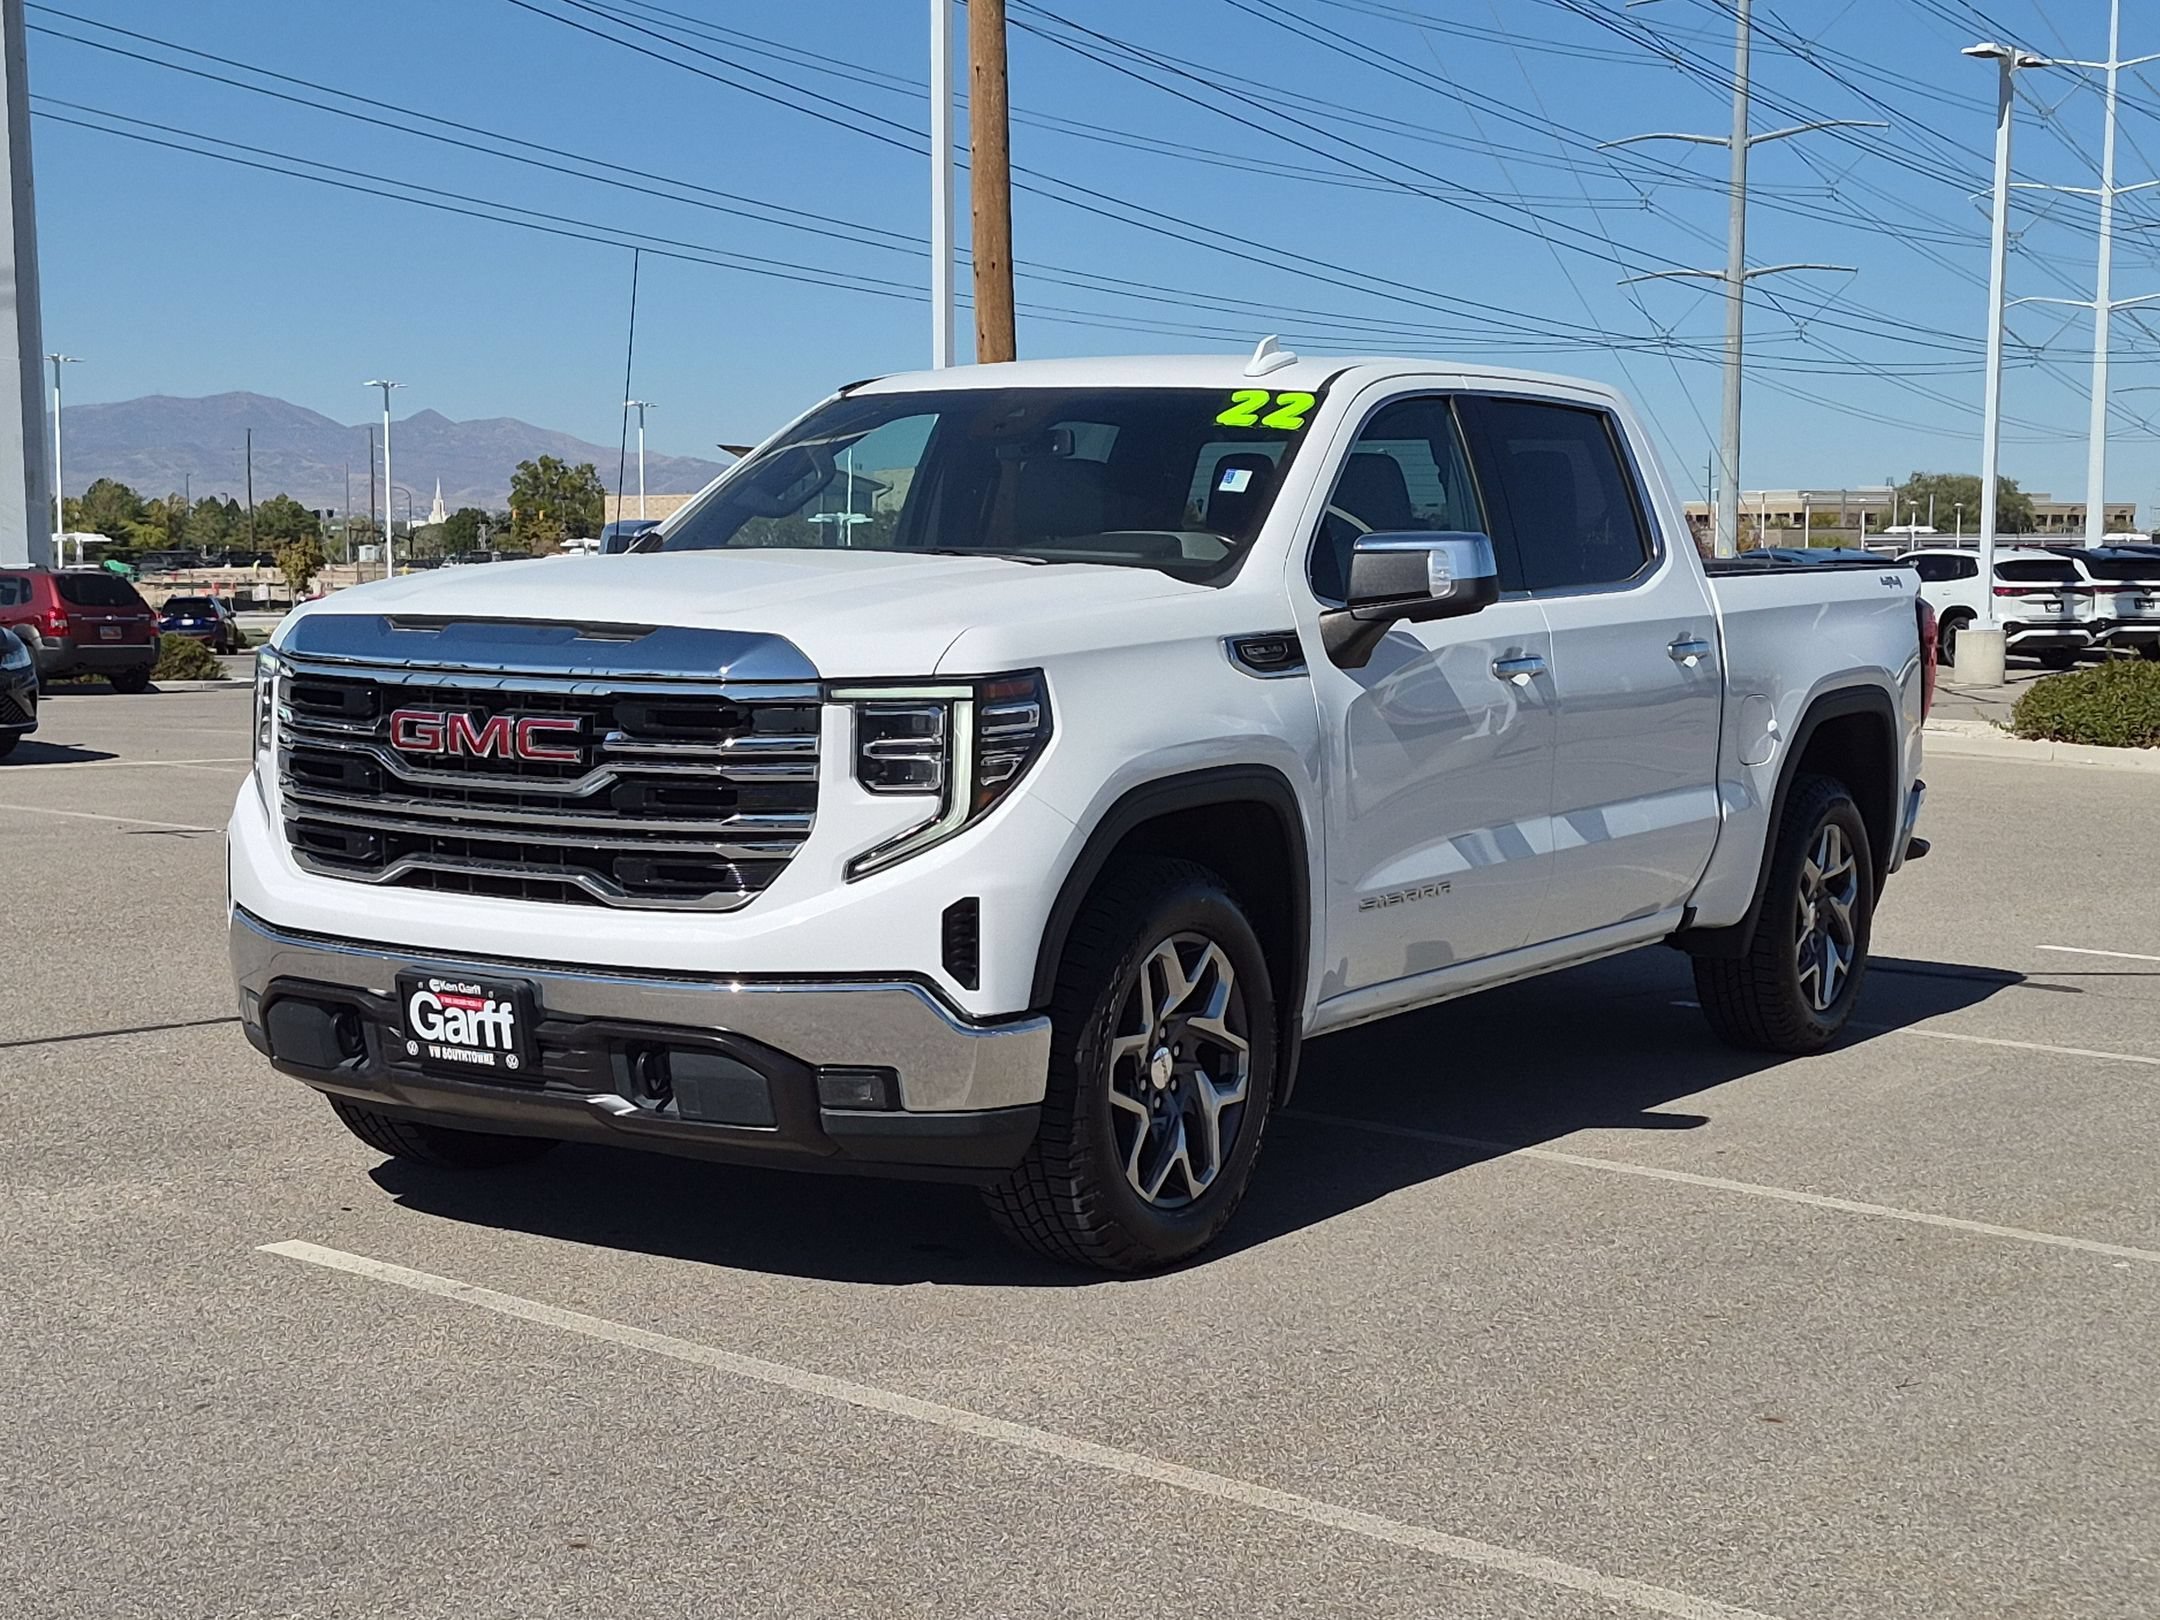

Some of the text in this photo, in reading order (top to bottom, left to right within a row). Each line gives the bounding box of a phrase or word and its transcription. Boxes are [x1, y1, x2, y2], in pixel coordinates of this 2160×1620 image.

[1215, 389, 1316, 431] 22
[389, 708, 582, 764] GMC
[1359, 881, 1451, 912] SIERRA
[440, 981, 481, 995] Ken Garff
[409, 990, 515, 1050] Garff
